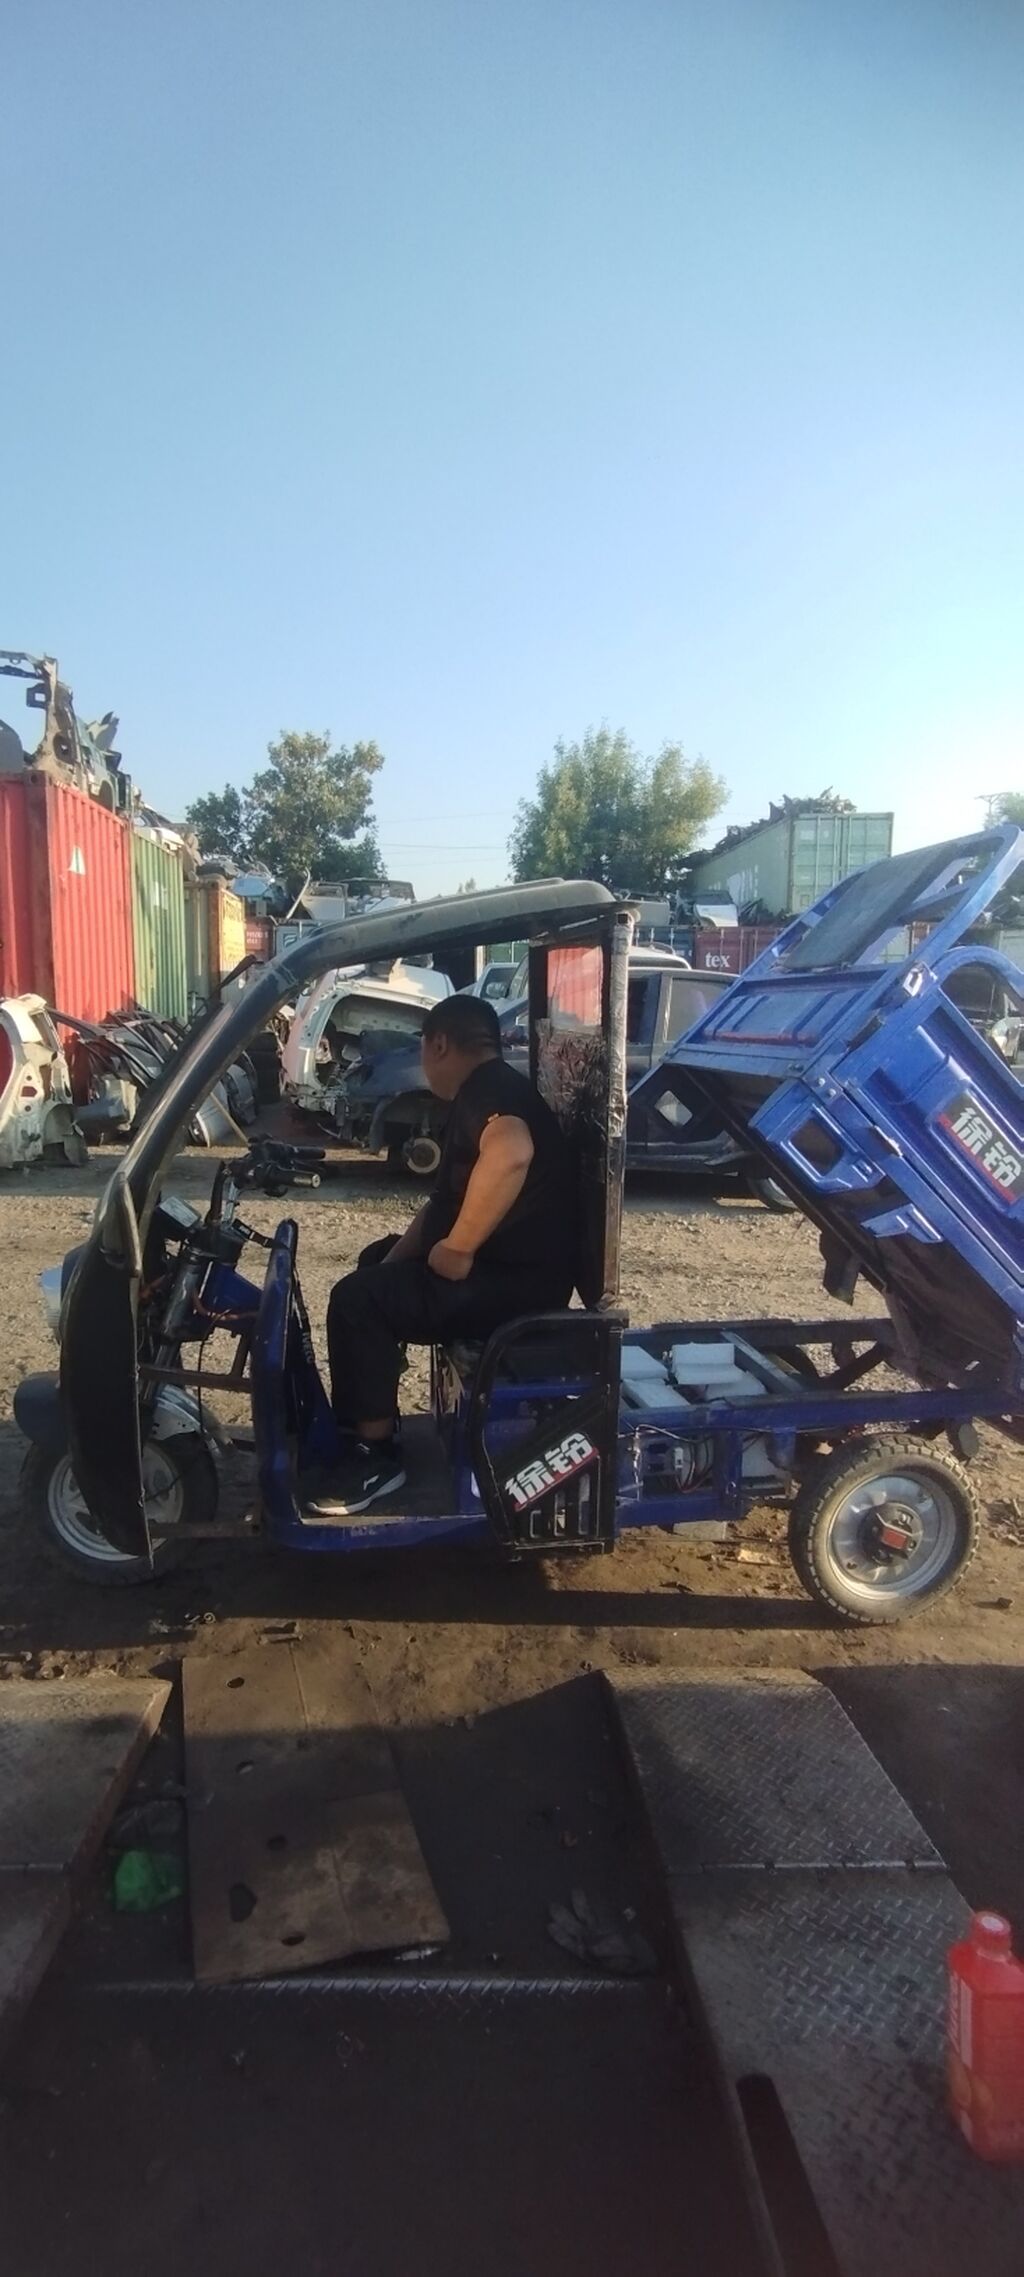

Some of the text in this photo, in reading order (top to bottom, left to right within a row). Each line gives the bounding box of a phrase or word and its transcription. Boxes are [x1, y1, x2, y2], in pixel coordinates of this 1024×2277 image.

[705, 952, 731, 968] tex
[950, 1106, 1022, 1188] 徐铃
[504, 1432, 594, 1505] 徐铃
